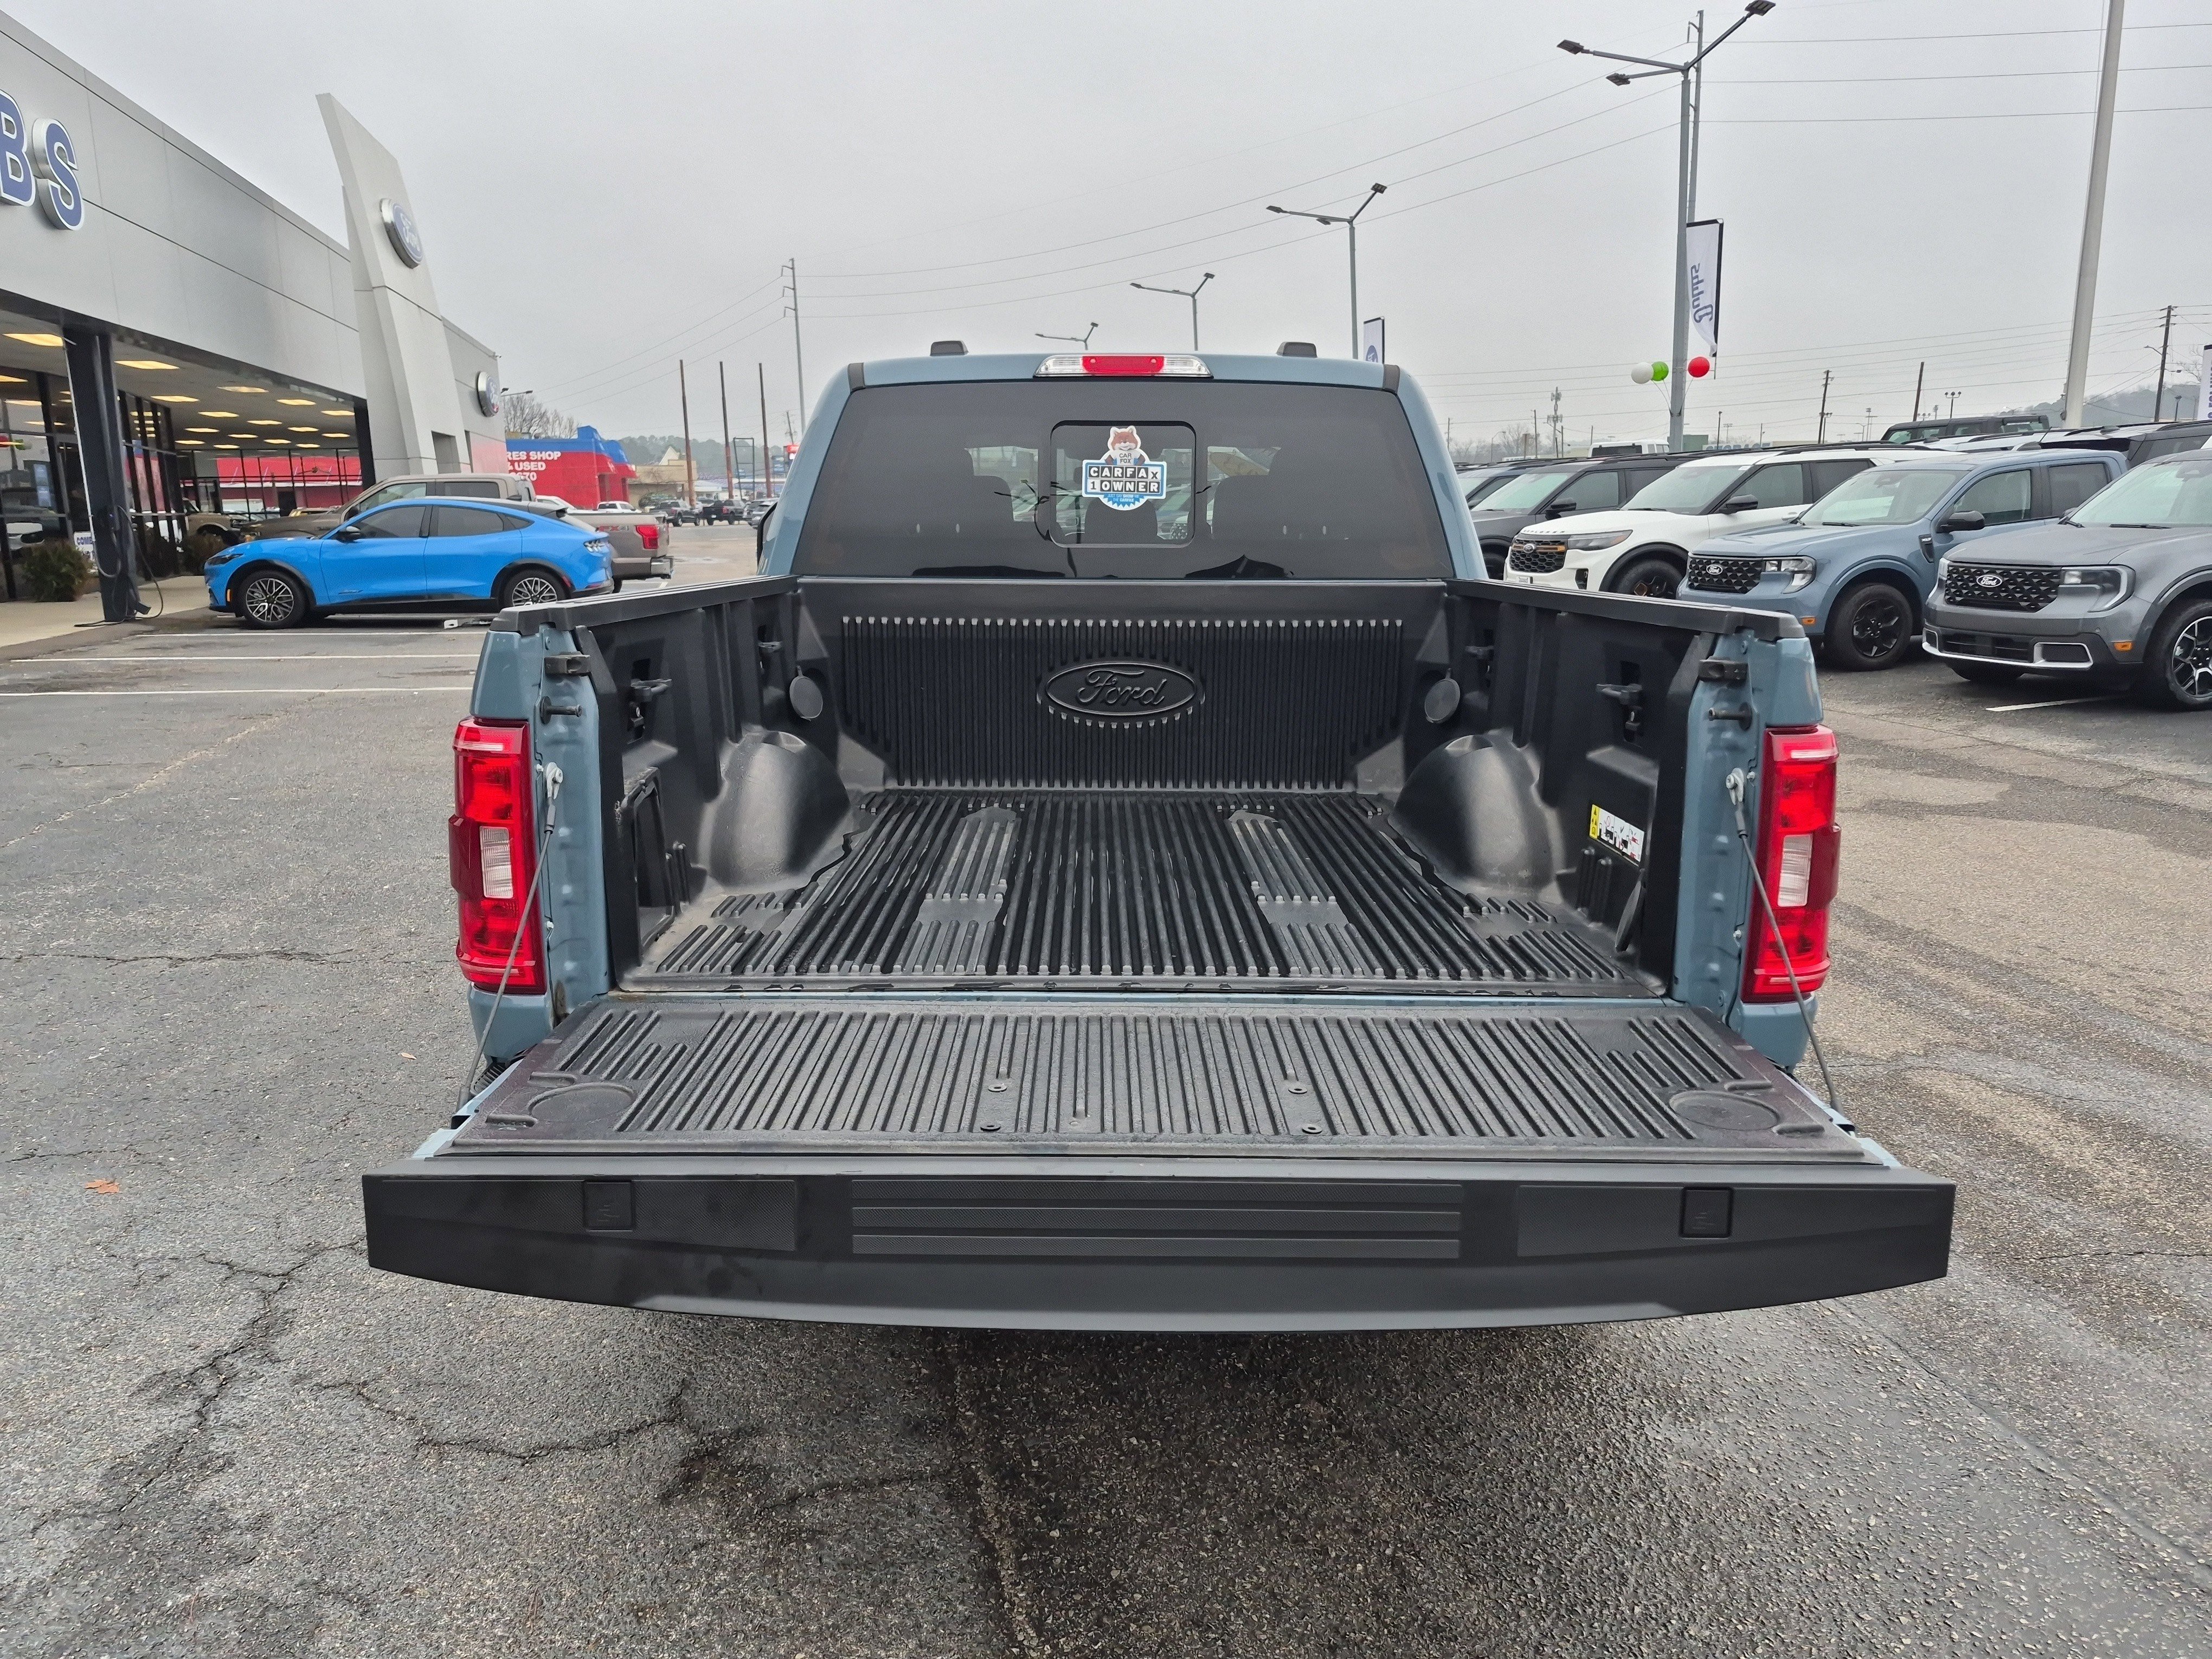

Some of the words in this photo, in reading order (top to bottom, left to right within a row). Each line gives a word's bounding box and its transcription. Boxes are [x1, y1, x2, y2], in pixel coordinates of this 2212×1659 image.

[529, 451, 561, 460] SHOP
[515, 461, 546, 471] USED
[1090, 467, 1159, 479] CARFAX
[1090, 481, 1097, 490] 1
[1101, 481, 1159, 492] OWNER
[1980, 576, 1997, 586] Ford
[1077, 668, 1167, 705] Ford
